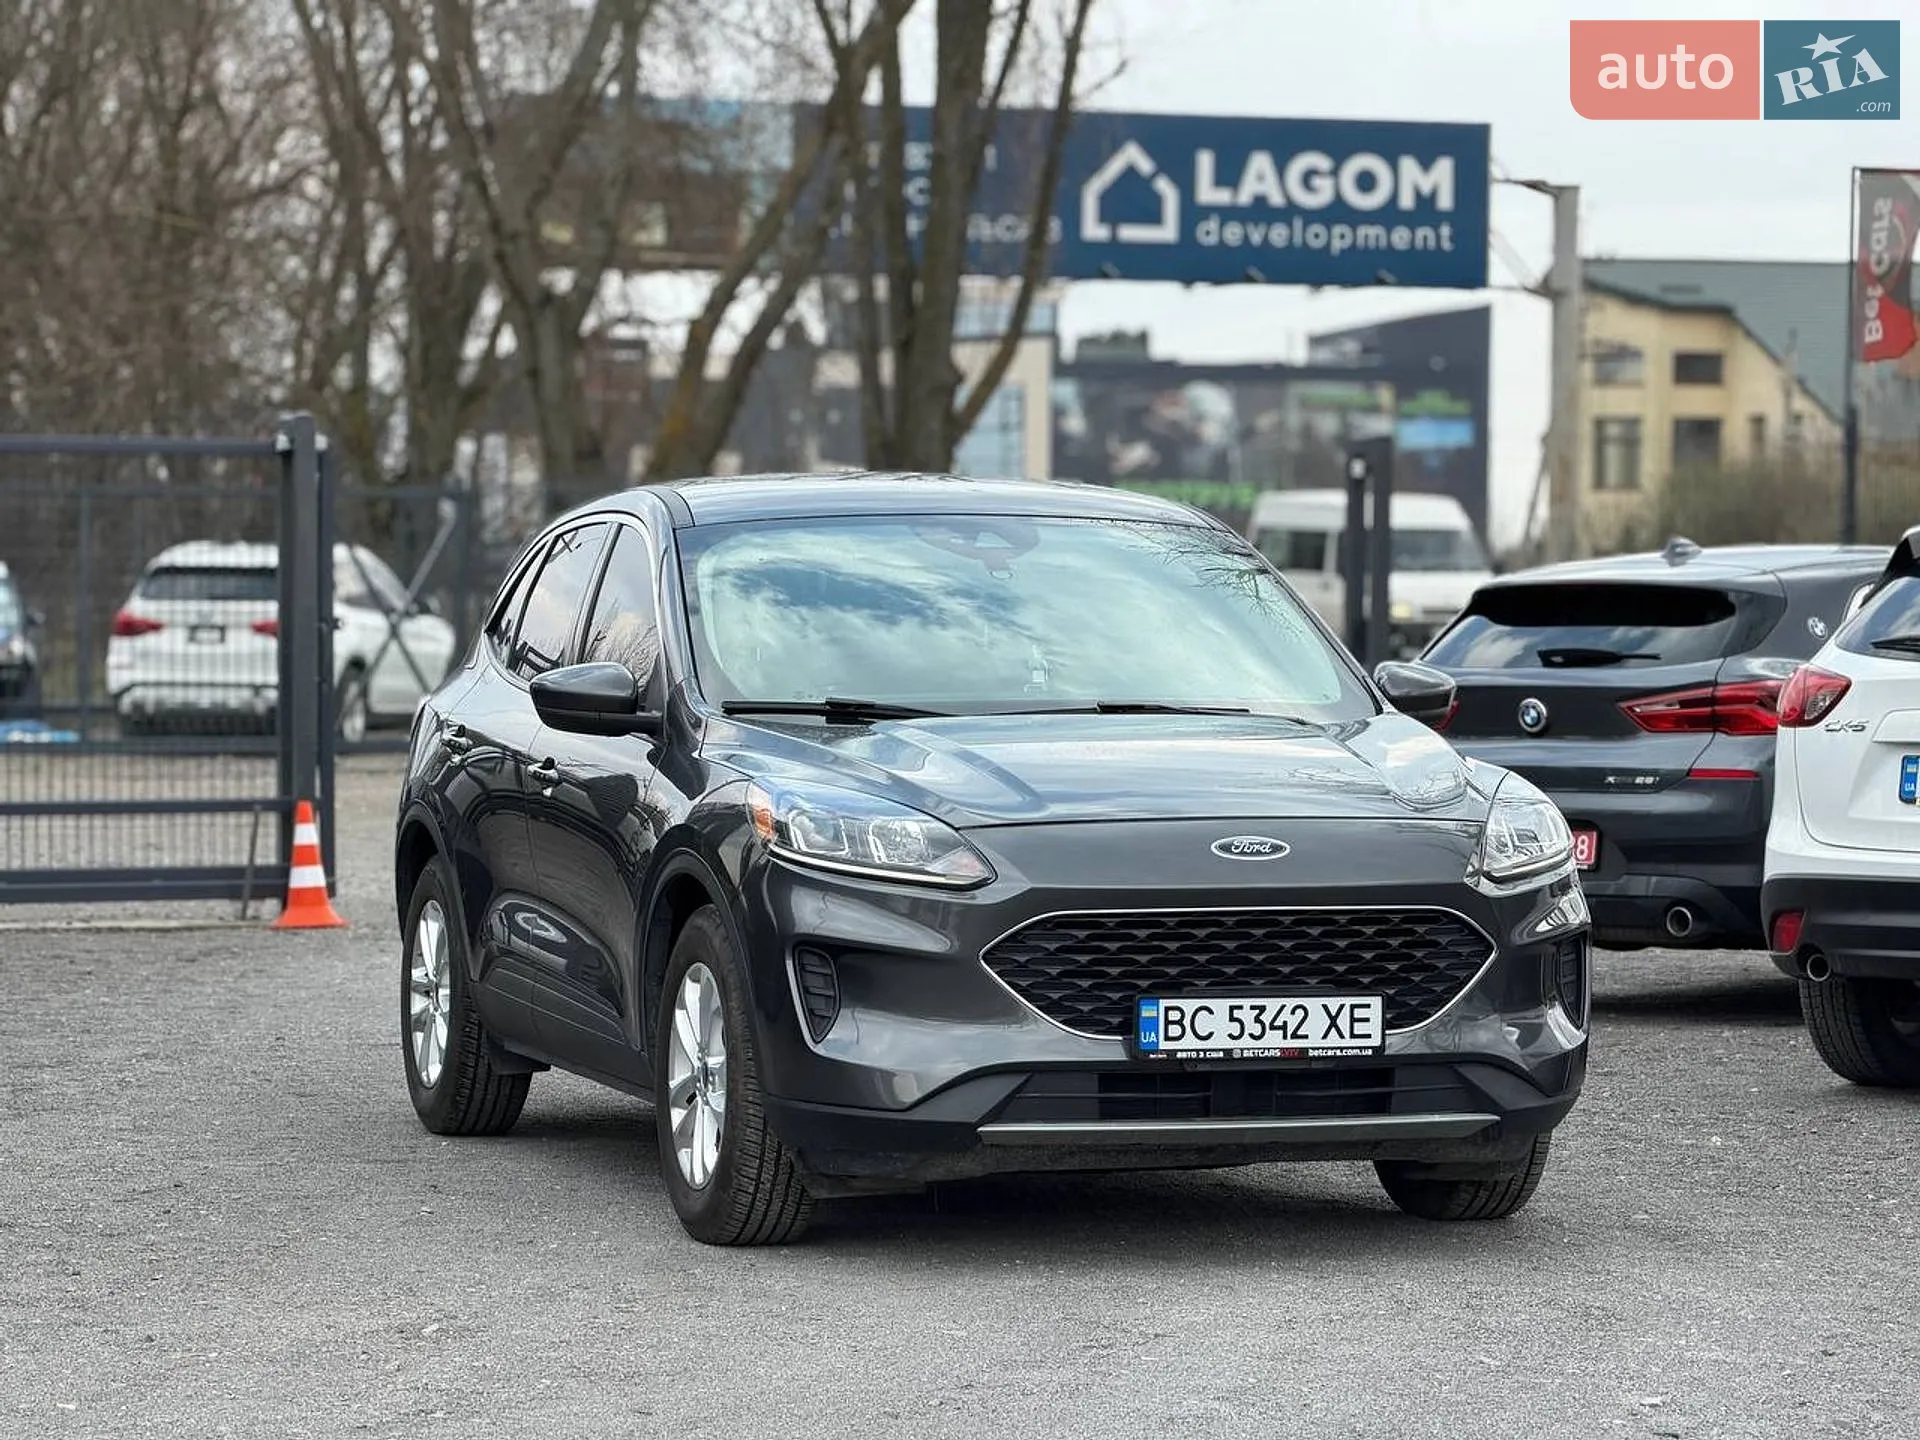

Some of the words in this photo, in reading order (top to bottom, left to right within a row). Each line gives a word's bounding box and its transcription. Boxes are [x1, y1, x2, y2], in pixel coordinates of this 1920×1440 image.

[1194, 147, 1456, 212] LAGOM
[1194, 212, 1455, 257] development
[1231, 839, 1272, 853] Ford
[1163, 1005, 1215, 1042] BC
[1226, 1004, 1310, 1041] 5342
[1321, 1003, 1372, 1039] XE
[1141, 1031, 1158, 1043] UA
[1308, 1047, 1373, 1058] betcars.com.ua
